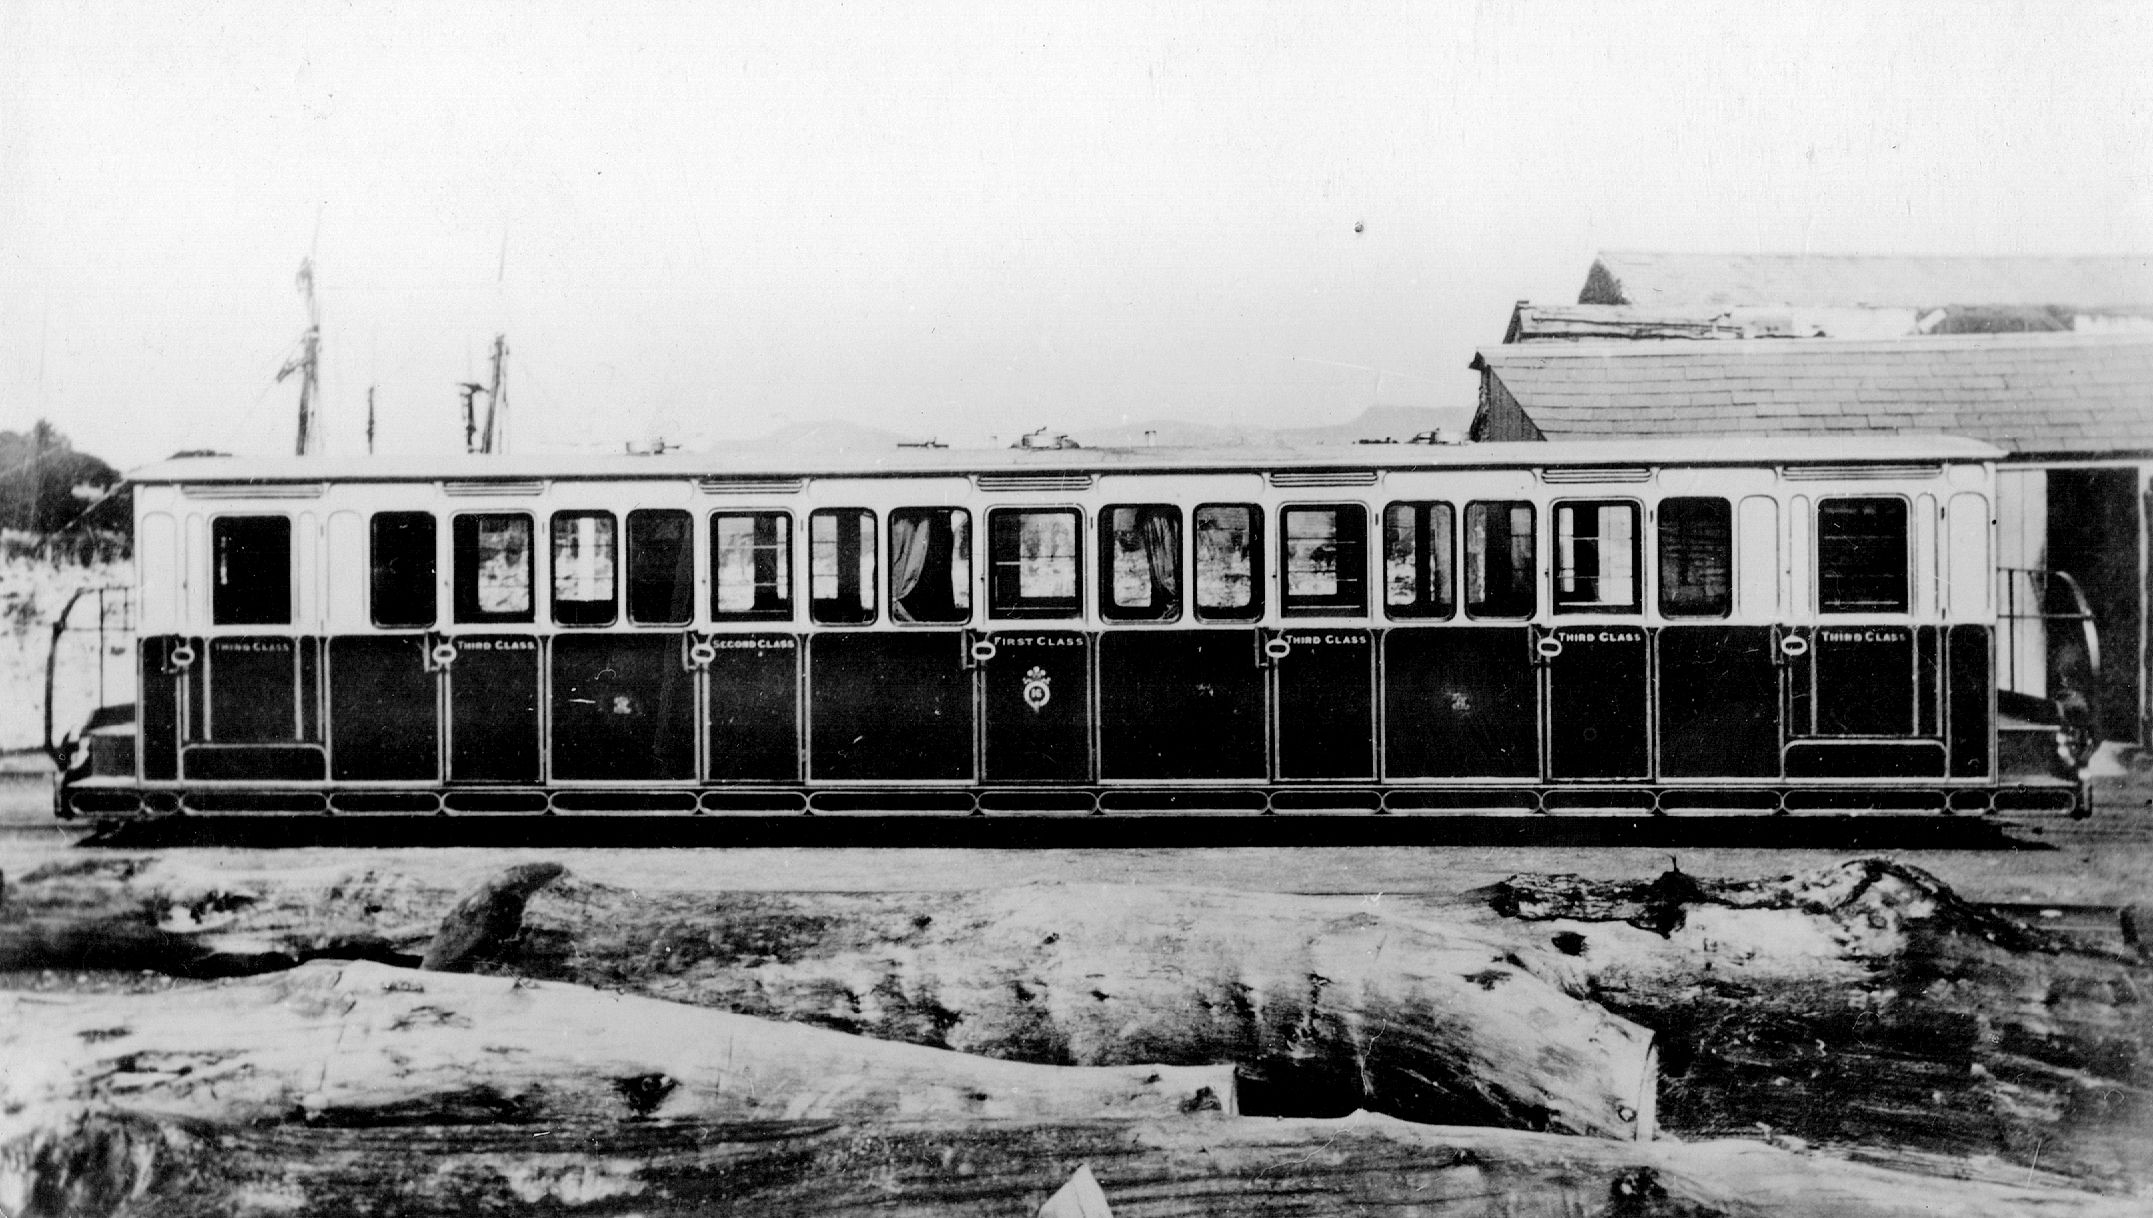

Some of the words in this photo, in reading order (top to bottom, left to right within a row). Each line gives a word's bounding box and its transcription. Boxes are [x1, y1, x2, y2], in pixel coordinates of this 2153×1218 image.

[994, 636, 1033, 646] FIRST
[1036, 636, 1084, 646] CLASS
[1285, 634, 1321, 645] THIRD
[1324, 634, 1367, 645] CLASS
[1558, 632, 1596, 643] THIRD
[1599, 631, 1641, 643] CLASS
[1821, 631, 1863, 642] THIRD
[1865, 631, 1906, 642] CLASS
[457, 640, 492, 651] THIRD
[495, 640, 536, 651] CLASS
[713, 639, 756, 649] SECOND
[757, 639, 795, 649] CLASS
